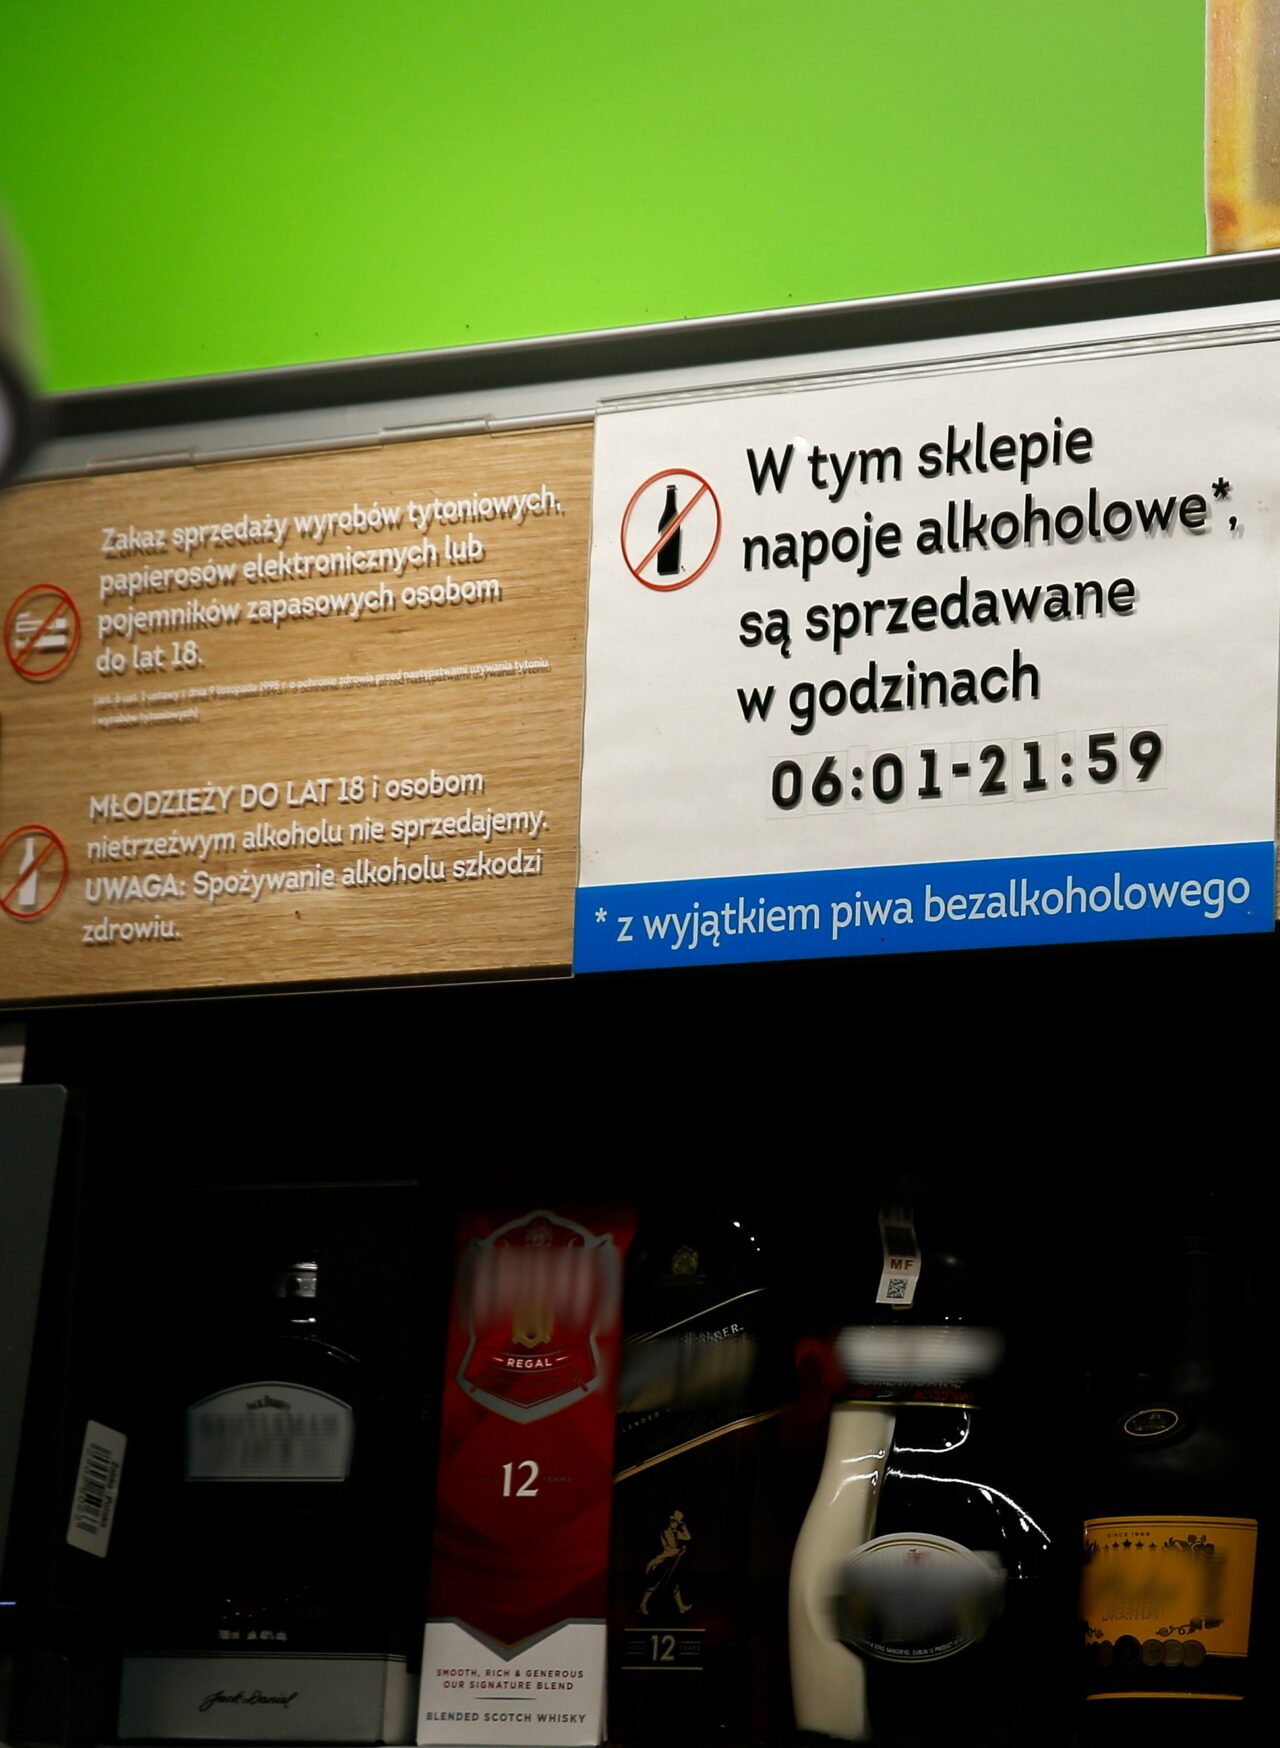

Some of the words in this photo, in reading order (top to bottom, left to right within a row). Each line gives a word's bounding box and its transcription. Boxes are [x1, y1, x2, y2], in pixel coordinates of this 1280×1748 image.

[746, 444, 795, 496] W
[809, 441, 900, 501] tym
[918, 416, 1094, 483] sklepie
[102, 525, 167, 553] Zakaz
[172, 512, 288, 555] sprzedaży
[294, 503, 402, 542] wyrobów
[407, 484, 562, 530] tytoniowych,
[743, 512, 901, 580] napoje
[100, 561, 236, 598] papierosów
[243, 539, 440, 579] elektronicznych
[444, 534, 484, 562] lub
[97, 597, 240, 638] pojemników
[247, 583, 393, 626] zapasowych
[401, 576, 501, 606] osobom
[738, 607, 791, 657] są
[806, 575, 1137, 655] sprzedawane
[96, 648, 127, 674] do
[132, 645, 166, 669] lat
[172, 640, 204, 666] 18.
[737, 683, 775, 723] w
[789, 649, 1041, 735] godzinach
[89, 786, 234, 821] MŁODZIEŻY
[240, 783, 280, 809] DO
[286, 778, 335, 805] LAT
[338, 775, 365, 802] 18
[371, 774, 380, 799] i
[385, 770, 484, 798] osobom
[770, 730, 1163, 811] 06:01-21:59
[87, 826, 236, 863] nietrzeźwym
[242, 815, 343, 850] alkoholu
[349, 814, 386, 843] nie
[391, 806, 549, 846] sprzedajemy.
[86, 872, 186, 904] UWAGA:
[193, 863, 336, 903] Spożywanie
[342, 852, 446, 887] alkoholu
[452, 847, 543, 882] szkodzi
[82, 914, 182, 946] zdrowiu.
[616, 914, 636, 943] z
[643, 896, 820, 950] wyjątkiem
[831, 888, 914, 941] piwa
[924, 873, 1252, 924] bezalkoholowego
[506, 1357, 552, 1369] REGAL
[502, 1459, 541, 1498] 12
[436, 1668, 480, 1678] SMOOTH,
[485, 1669, 511, 1678] RICH
[526, 1669, 584, 1679] GENEROUS
[650, 1634, 676, 1661] 12
[443, 1680, 465, 1690] OUR
[469, 1681, 531, 1690] SIGNATURE
[536, 1681, 574, 1691] BLEND
[426, 1711, 480, 1722] BLENDED
[484, 1712, 532, 1723] SCOTCH
[537, 1713, 587, 1724] WHISKY
